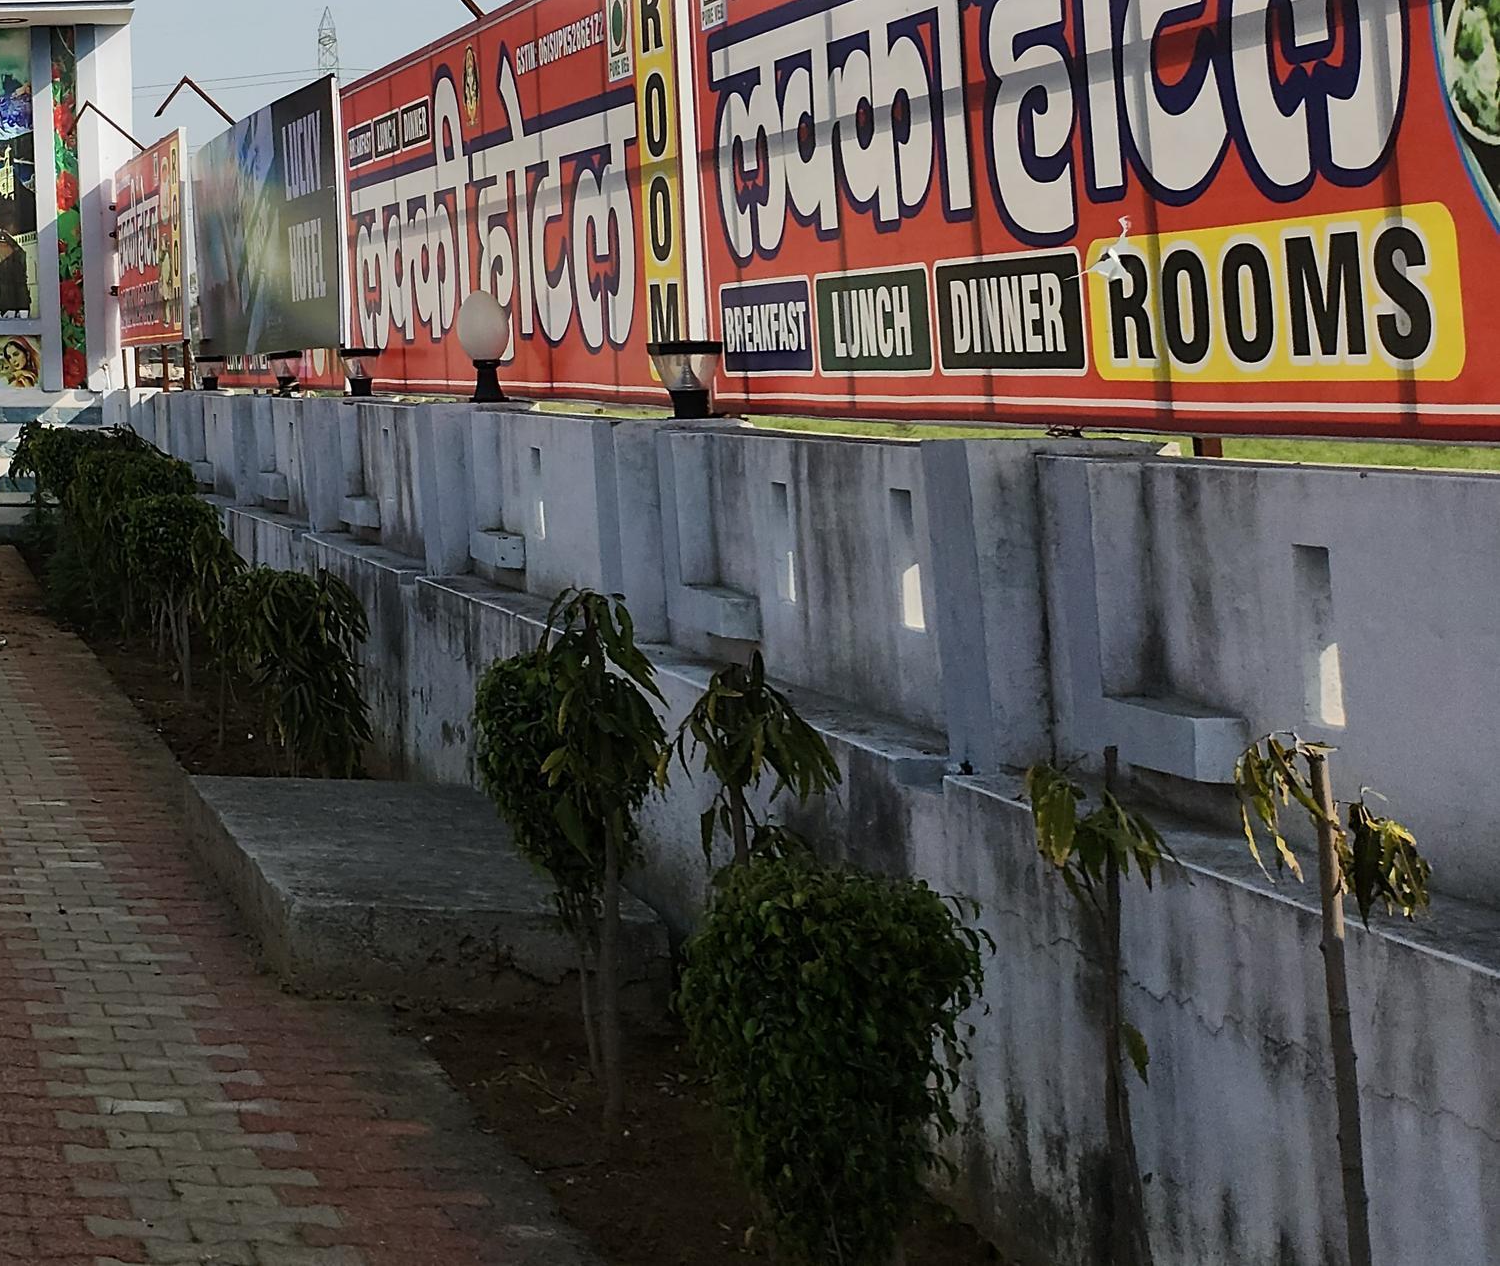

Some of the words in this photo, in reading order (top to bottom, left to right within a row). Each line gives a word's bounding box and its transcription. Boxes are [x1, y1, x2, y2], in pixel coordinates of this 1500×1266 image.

[282, 109, 322, 202] LUCKY
[376, 118, 397, 152] LUNCH
[403, 106, 428, 143] DINNER
[351, 77, 469, 350] लक्की
[288, 217, 327, 303] HOTEL
[1110, 226, 1432, 366] ROOMS
[723, 300, 807, 353] BREAKFAST
[831, 284, 914, 360] LUNCH
[950, 270, 1068, 355] DINNER
